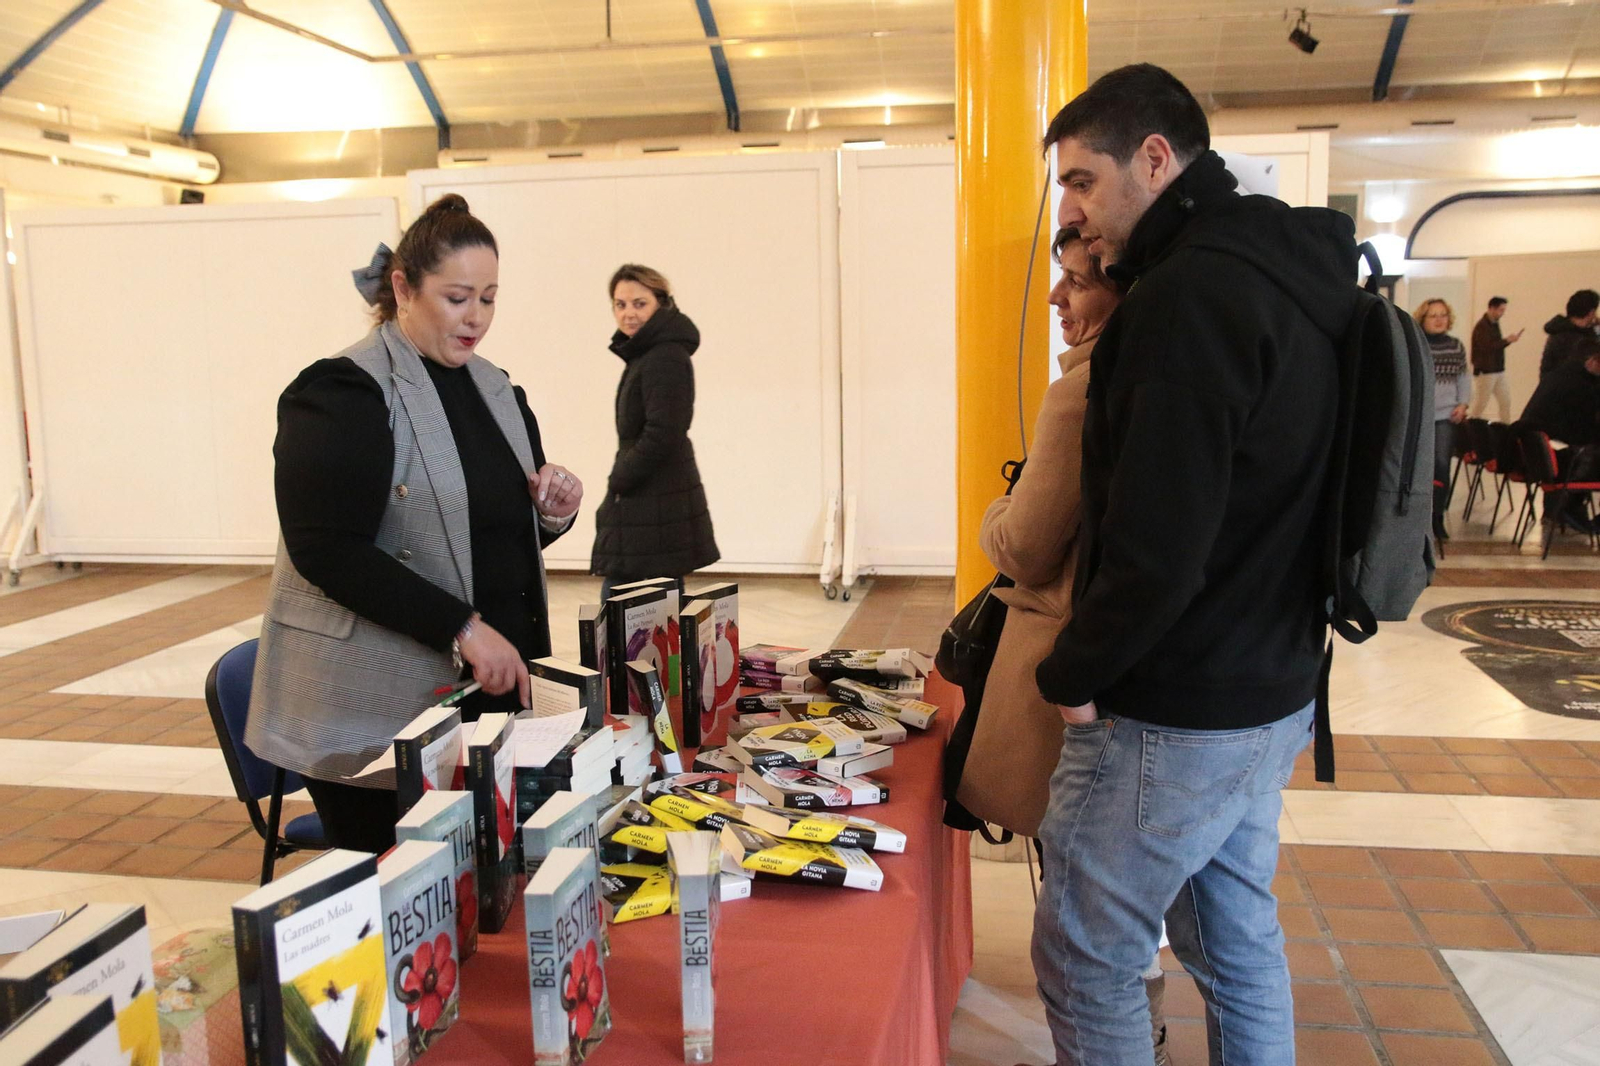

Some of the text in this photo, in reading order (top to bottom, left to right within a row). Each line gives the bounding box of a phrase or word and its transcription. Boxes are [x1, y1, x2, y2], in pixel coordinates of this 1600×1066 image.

[654, 682, 662, 702] CARMEN
[838, 689, 856, 698] CARMEN
[667, 798, 690, 810] CARMEN
[668, 806, 684, 815] MOLA
[630, 830, 654, 842] CARMEN
[839, 836, 857, 844] GITANA
[631, 838, 648, 847] MOLA
[758, 856, 783, 865] CARMEN
[802, 871, 823, 880] GITANA
[809, 866, 827, 874] NOVIA
[629, 902, 653, 911] CARMEN
[388, 875, 453, 956] BESTIA
[282, 900, 354, 944] Carmen Mola
[556, 881, 598, 963] BESTIA
[684, 909, 708, 967] BESTIA
[284, 932, 331, 964] Las madres
[530, 929, 556, 989] BESTIA
[100, 958, 126, 982] Mola
